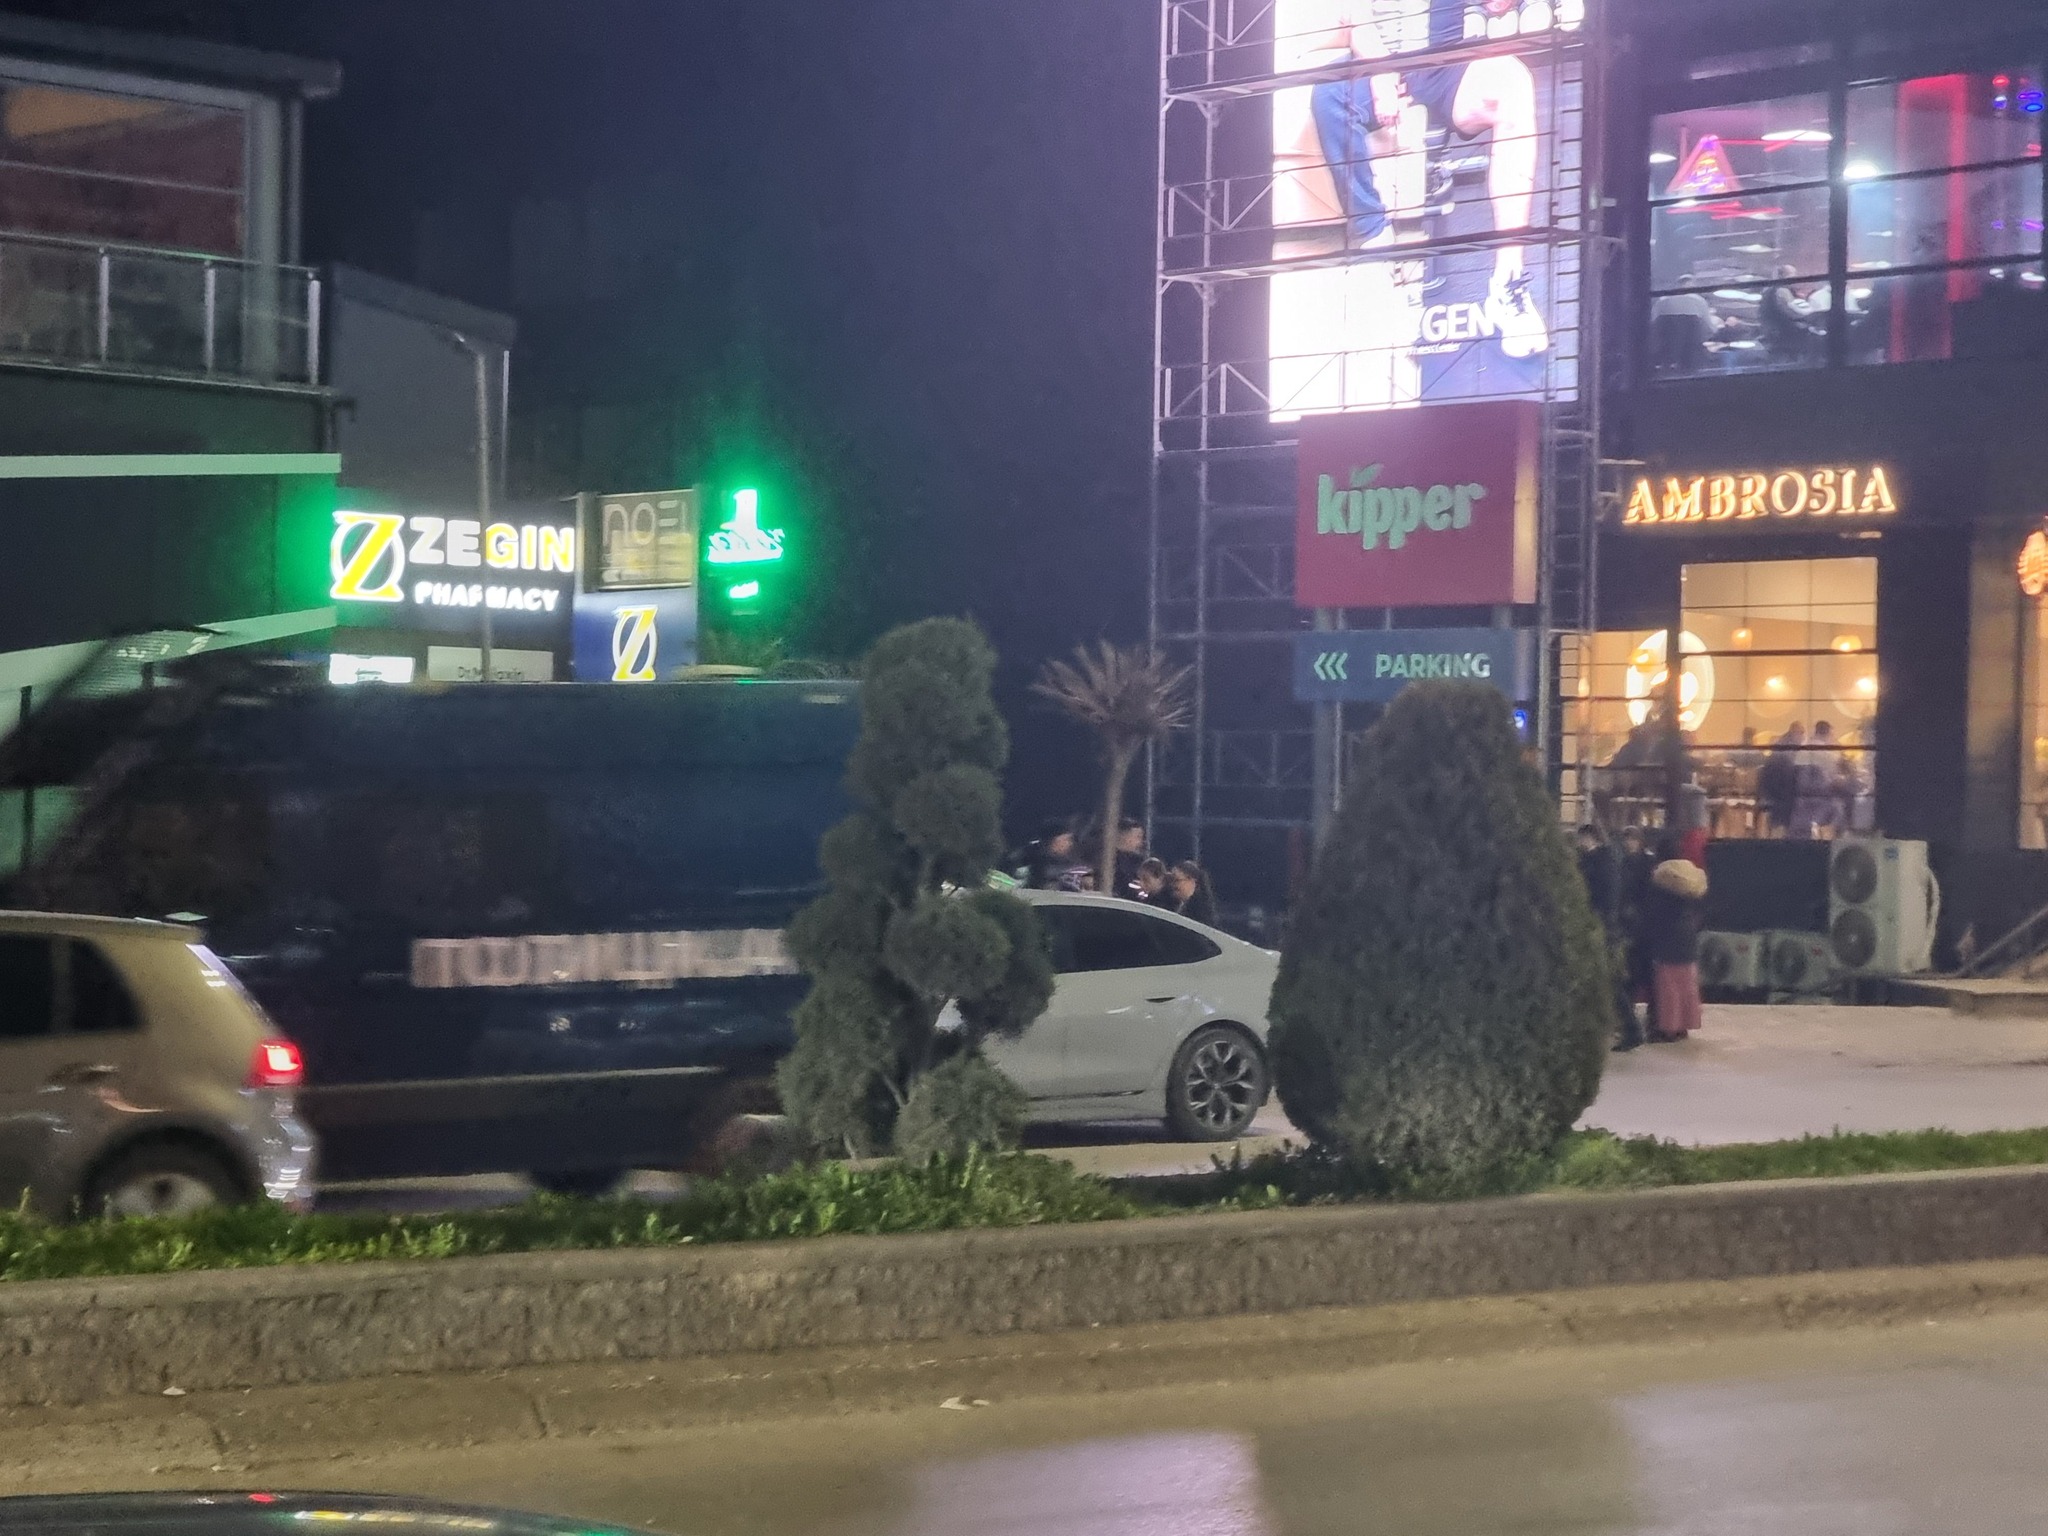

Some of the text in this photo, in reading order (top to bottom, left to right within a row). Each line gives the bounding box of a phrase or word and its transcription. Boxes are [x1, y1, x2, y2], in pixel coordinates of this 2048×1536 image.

[1317, 464, 1488, 550] kipper
[1622, 467, 1896, 525] AMBROSIA
[409, 517, 575, 573] ZEGIN
[1375, 652, 1491, 678] PARKING
